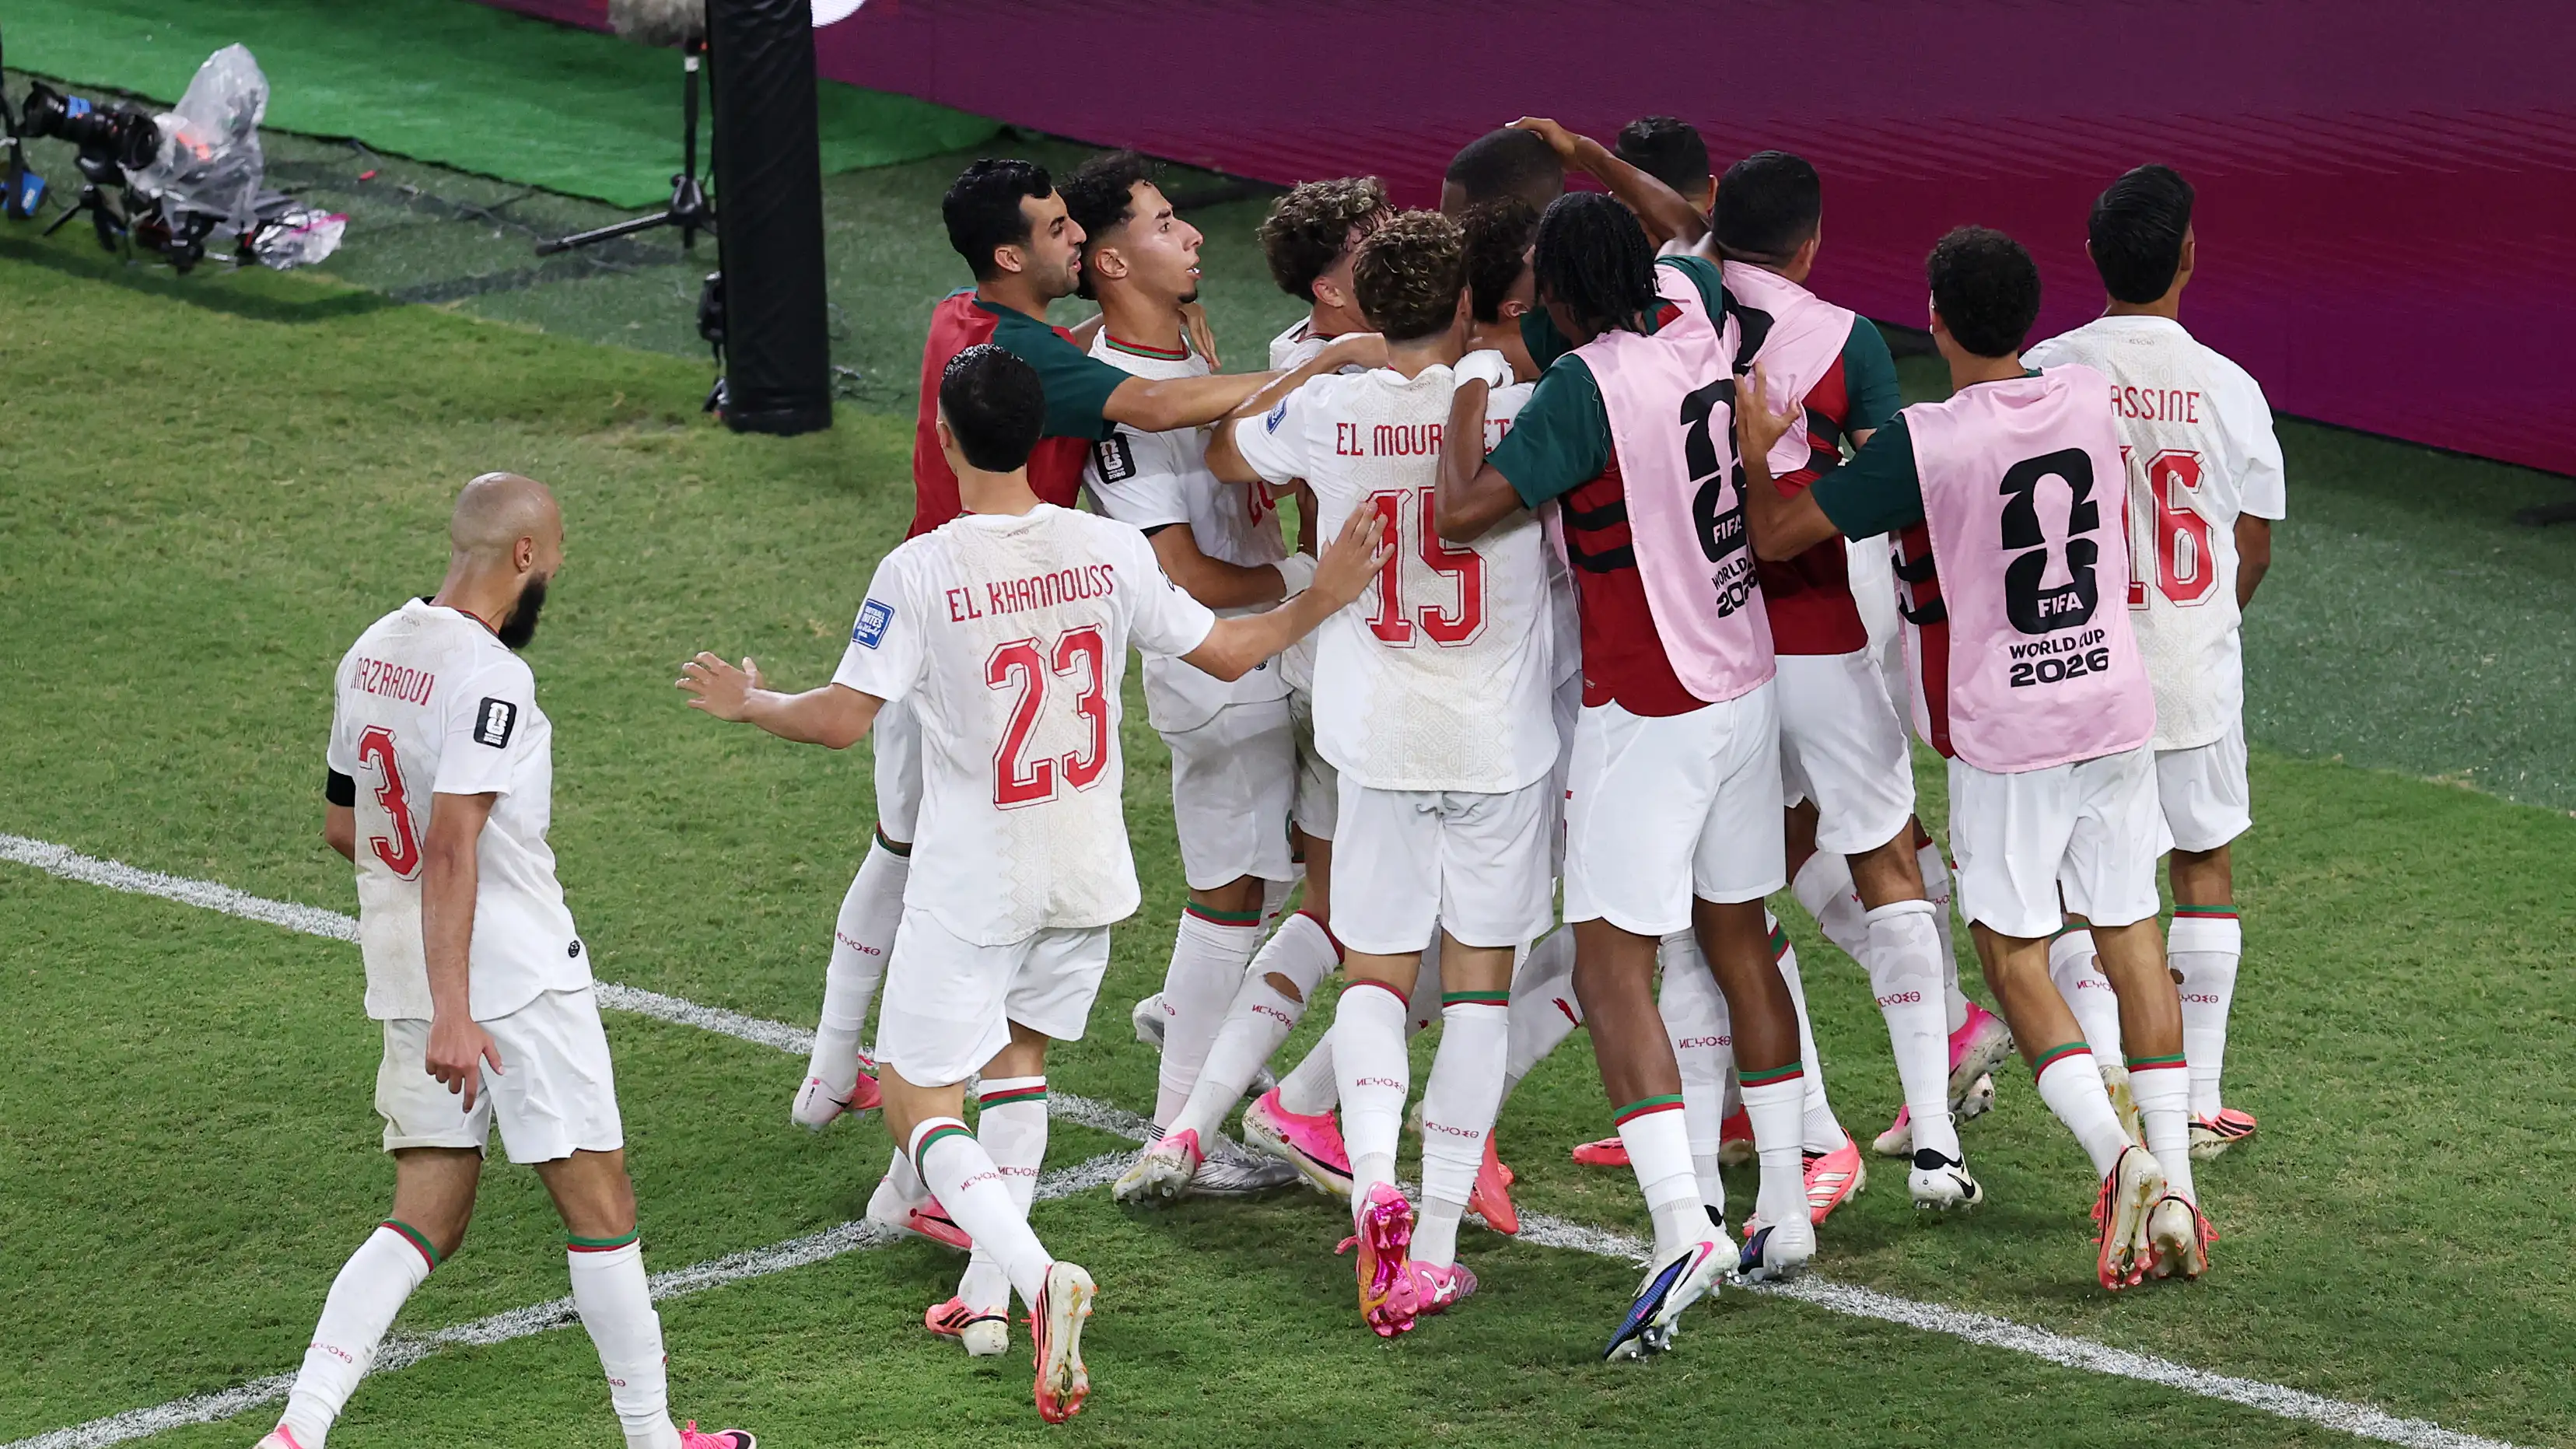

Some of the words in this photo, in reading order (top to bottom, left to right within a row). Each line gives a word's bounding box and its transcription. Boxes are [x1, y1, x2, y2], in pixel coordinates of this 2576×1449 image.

[2111, 385, 2200, 423] ASSINE
[1336, 422, 1363, 456] EL
[1374, 418, 1510, 457] MOURET
[1364, 486, 1488, 649] 15
[1711, 557, 1747, 590] WORLD
[946, 587, 982, 622] EL
[986, 564, 1114, 615] KHANNOUSS
[2037, 591, 2084, 618] FIFA
[2009, 636, 2077, 660] WORLD
[2079, 628, 2105, 648] CUP
[351, 657, 435, 705] NAZRAOUI
[2009, 647, 2109, 688] 2026
[985, 623, 1111, 810] 23
[358, 725, 424, 881] 3
